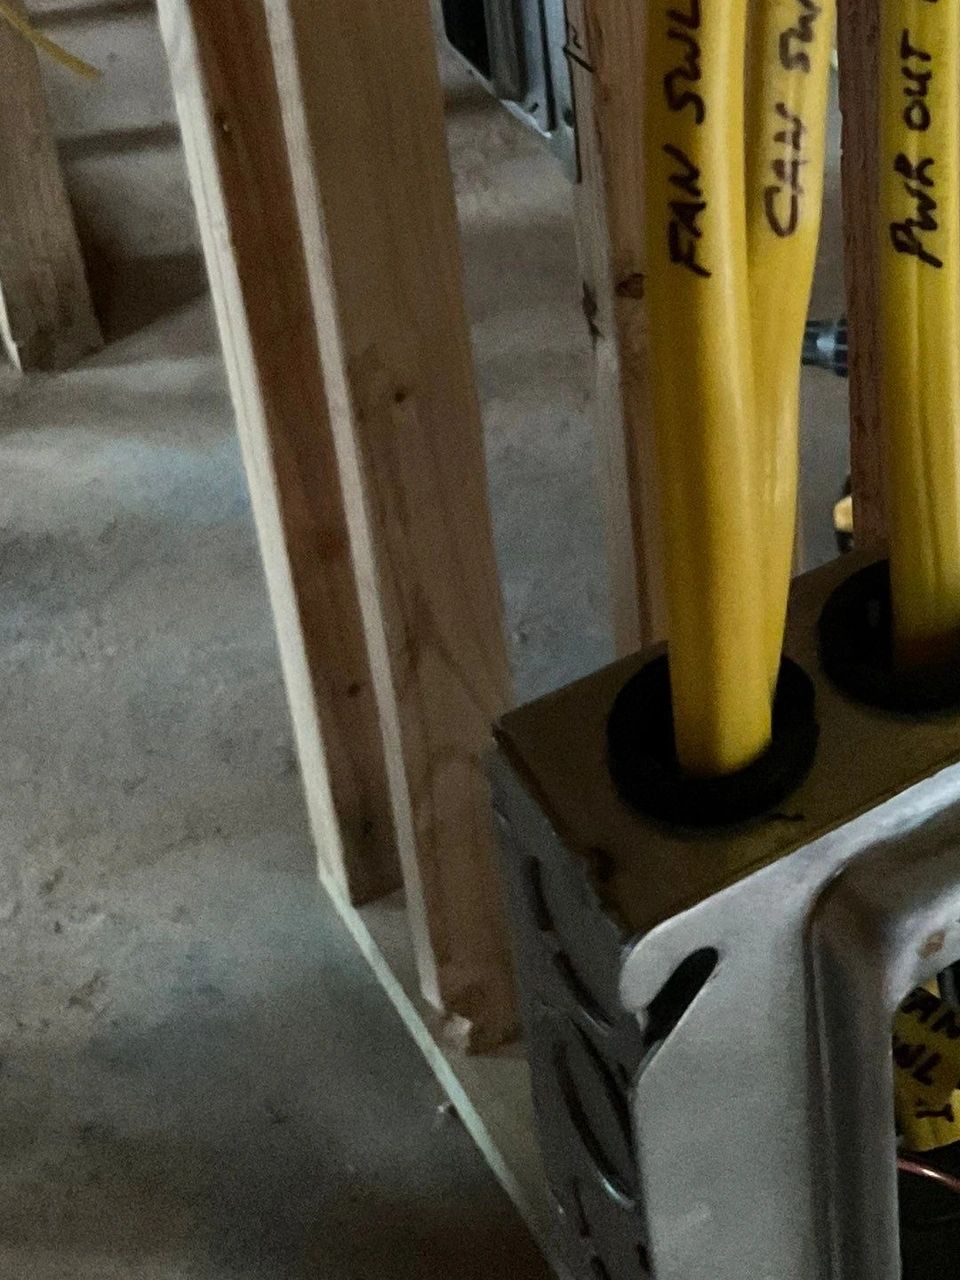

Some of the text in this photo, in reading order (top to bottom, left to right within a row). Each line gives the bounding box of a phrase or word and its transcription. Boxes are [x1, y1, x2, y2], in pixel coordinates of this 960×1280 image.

[899, 29, 932, 132] OUT
[662, 143, 712, 279] FAN
[763, 103, 807, 238] CAN
[888, 153, 943, 269] PWR
